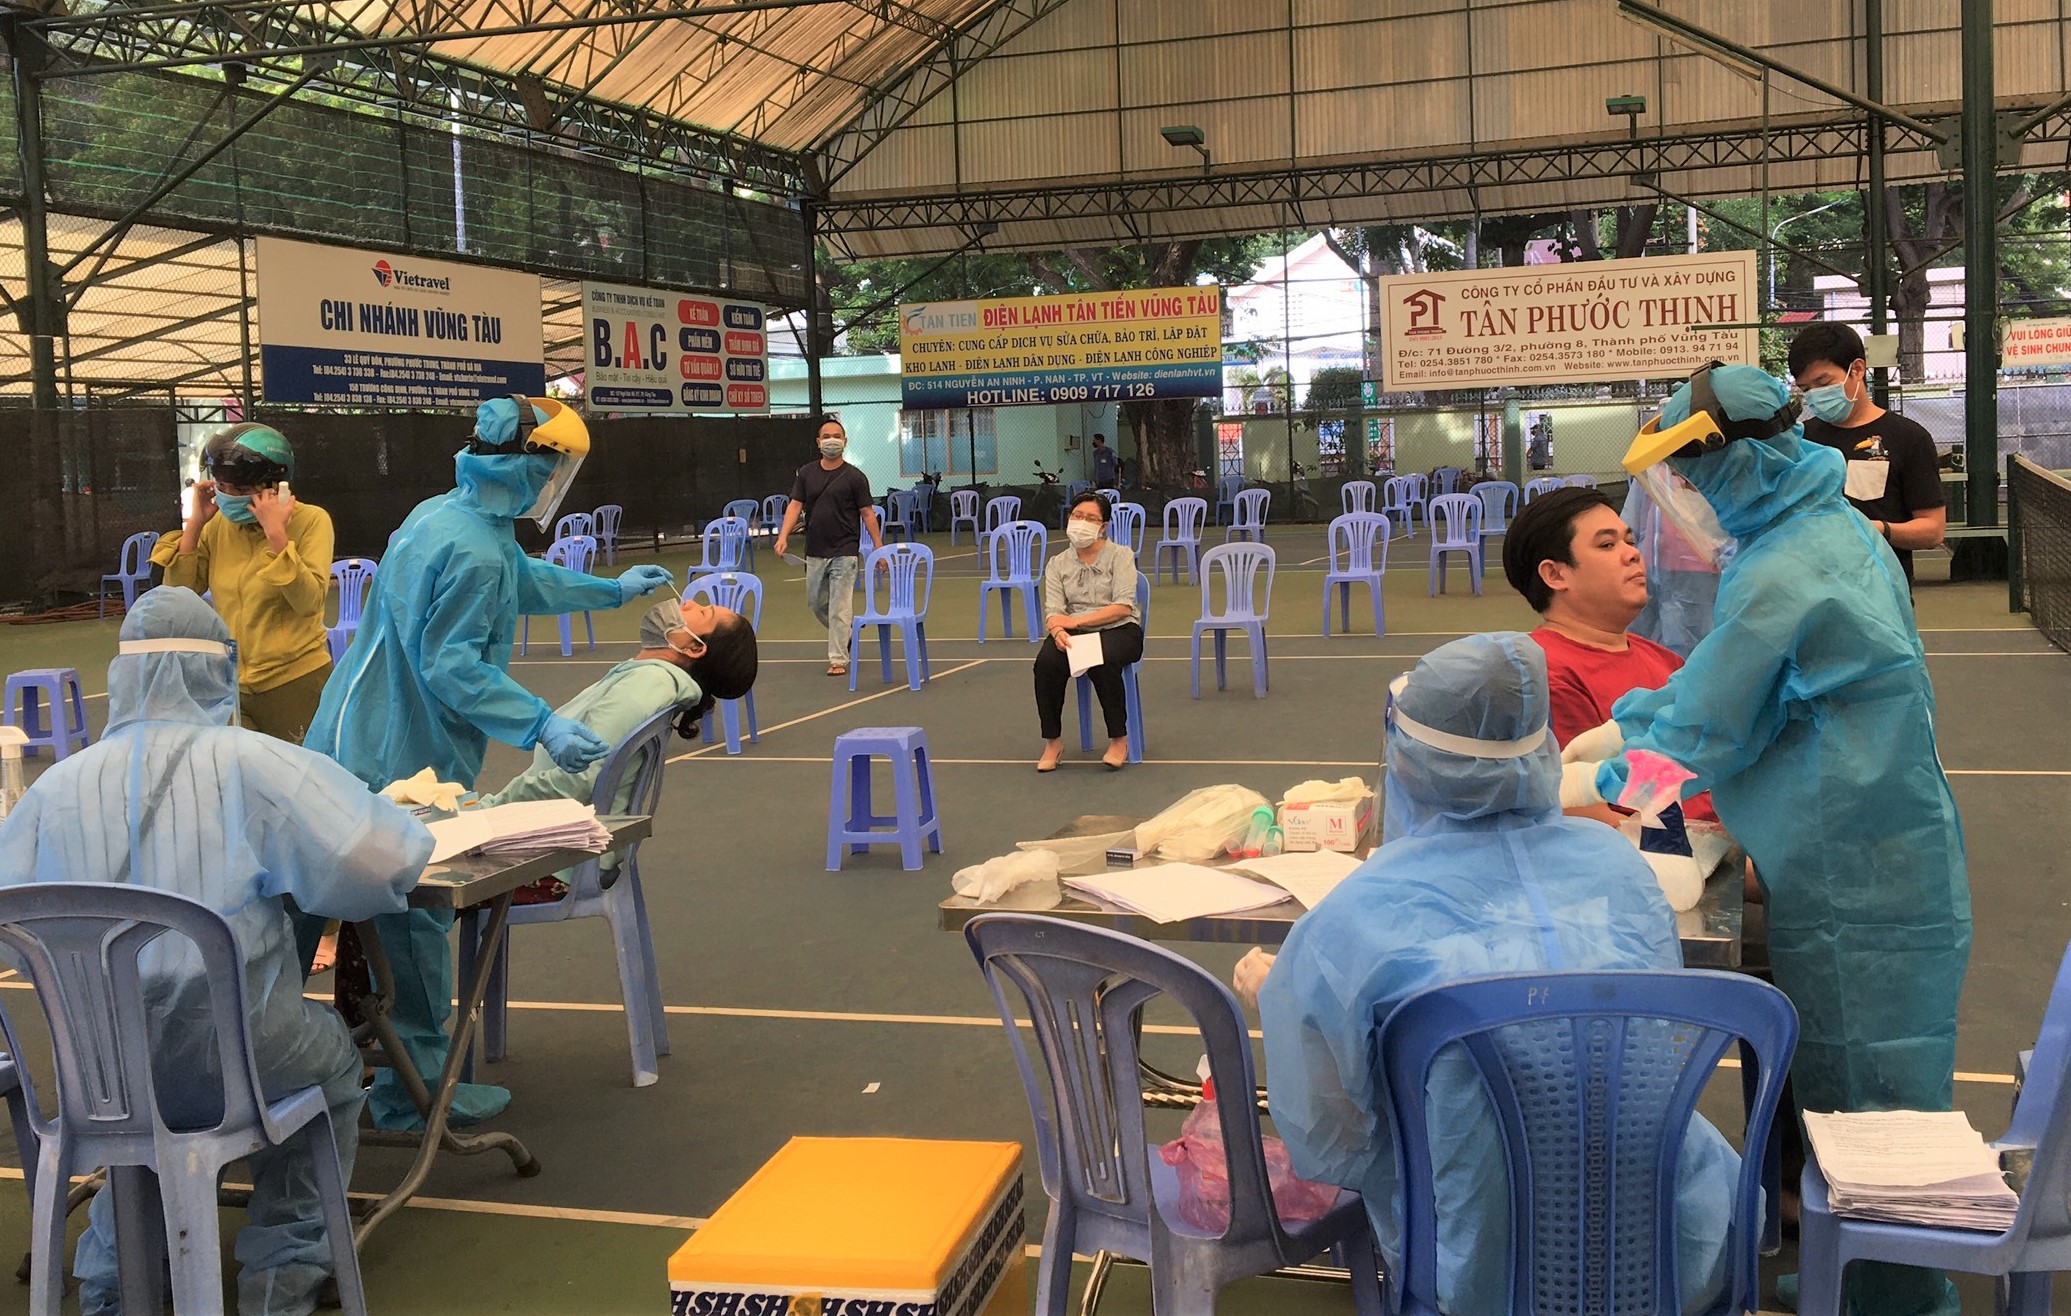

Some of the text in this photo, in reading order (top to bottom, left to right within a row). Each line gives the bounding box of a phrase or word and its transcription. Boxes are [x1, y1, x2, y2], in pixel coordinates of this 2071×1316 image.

[393, 269, 450, 291] Vietravel
[1461, 270, 1736, 300] CÔNG TY CỔ PHẦN ĐẦU TƯ VÀ XÂY DỰNG
[320, 298, 501, 345] CHI NHÁNH VŨNG TÀU
[920, 312, 977, 329] TAN TIEN
[983, 290, 1218, 331] ĐIỆN LẠNH TÂN TIẾN VŨNG TÀU
[1460, 292, 1738, 338] TÂN PHƯỚC THỊNH
[593, 318, 667, 371] B.A.C
[958, 339, 985, 352] CUNG
[988, 333, 1008, 350] CẤP
[1012, 336, 1036, 351] DỊCH
[1039, 335, 1053, 348] VỤ
[1056, 330, 1077, 346] SỬA
[1080, 330, 1111, 345] CHỮA,
[1115, 327, 1135, 343] BẢO
[1186, 324, 1208, 341] ĐẶT
[1398, 331, 1738, 358] Đ/c: 71 Đường 3/2, phường 8, Thành phố Vũng Tàu
[2011, 330, 2026, 341] VUI
[2029, 327, 2054, 340] LÒNG
[905, 362, 926, 373] KHO
[929, 360, 956, 374] LẠNH
[965, 356, 990, 371] ĐIỆN
[993, 357, 1020, 371] LẠNH
[1023, 353, 1044, 367] DÂN
[1047, 354, 1076, 368] DỤNG
[1085, 349, 1111, 366] ĐIỆN
[1114, 350, 1141, 365] LẠNH
[1145, 346, 1174, 361] CÔNG
[1177, 344, 1217, 360] NGHIỆP
[1398, 342, 1738, 368] Tel: 0254.3851 780 Fax: 0254.3573 180 Mobile: 0913. 94 71 94
[2006, 343, 2019, 359] VỆ
[2021, 344, 2043, 355] SINH
[1399, 353, 1739, 378] Email: info@tanphuocthinh.com.vn Website: www.tanphuocthinh.com.vn
[908, 367, 1215, 391] ĐC: 514 NGUYỄN AN NINH P. NAN TP. VT Website: dienlanhvt.vn
[967, 382, 1155, 405] HOTLINE: 0909 717 126
[1329, 818, 1343, 830] M
